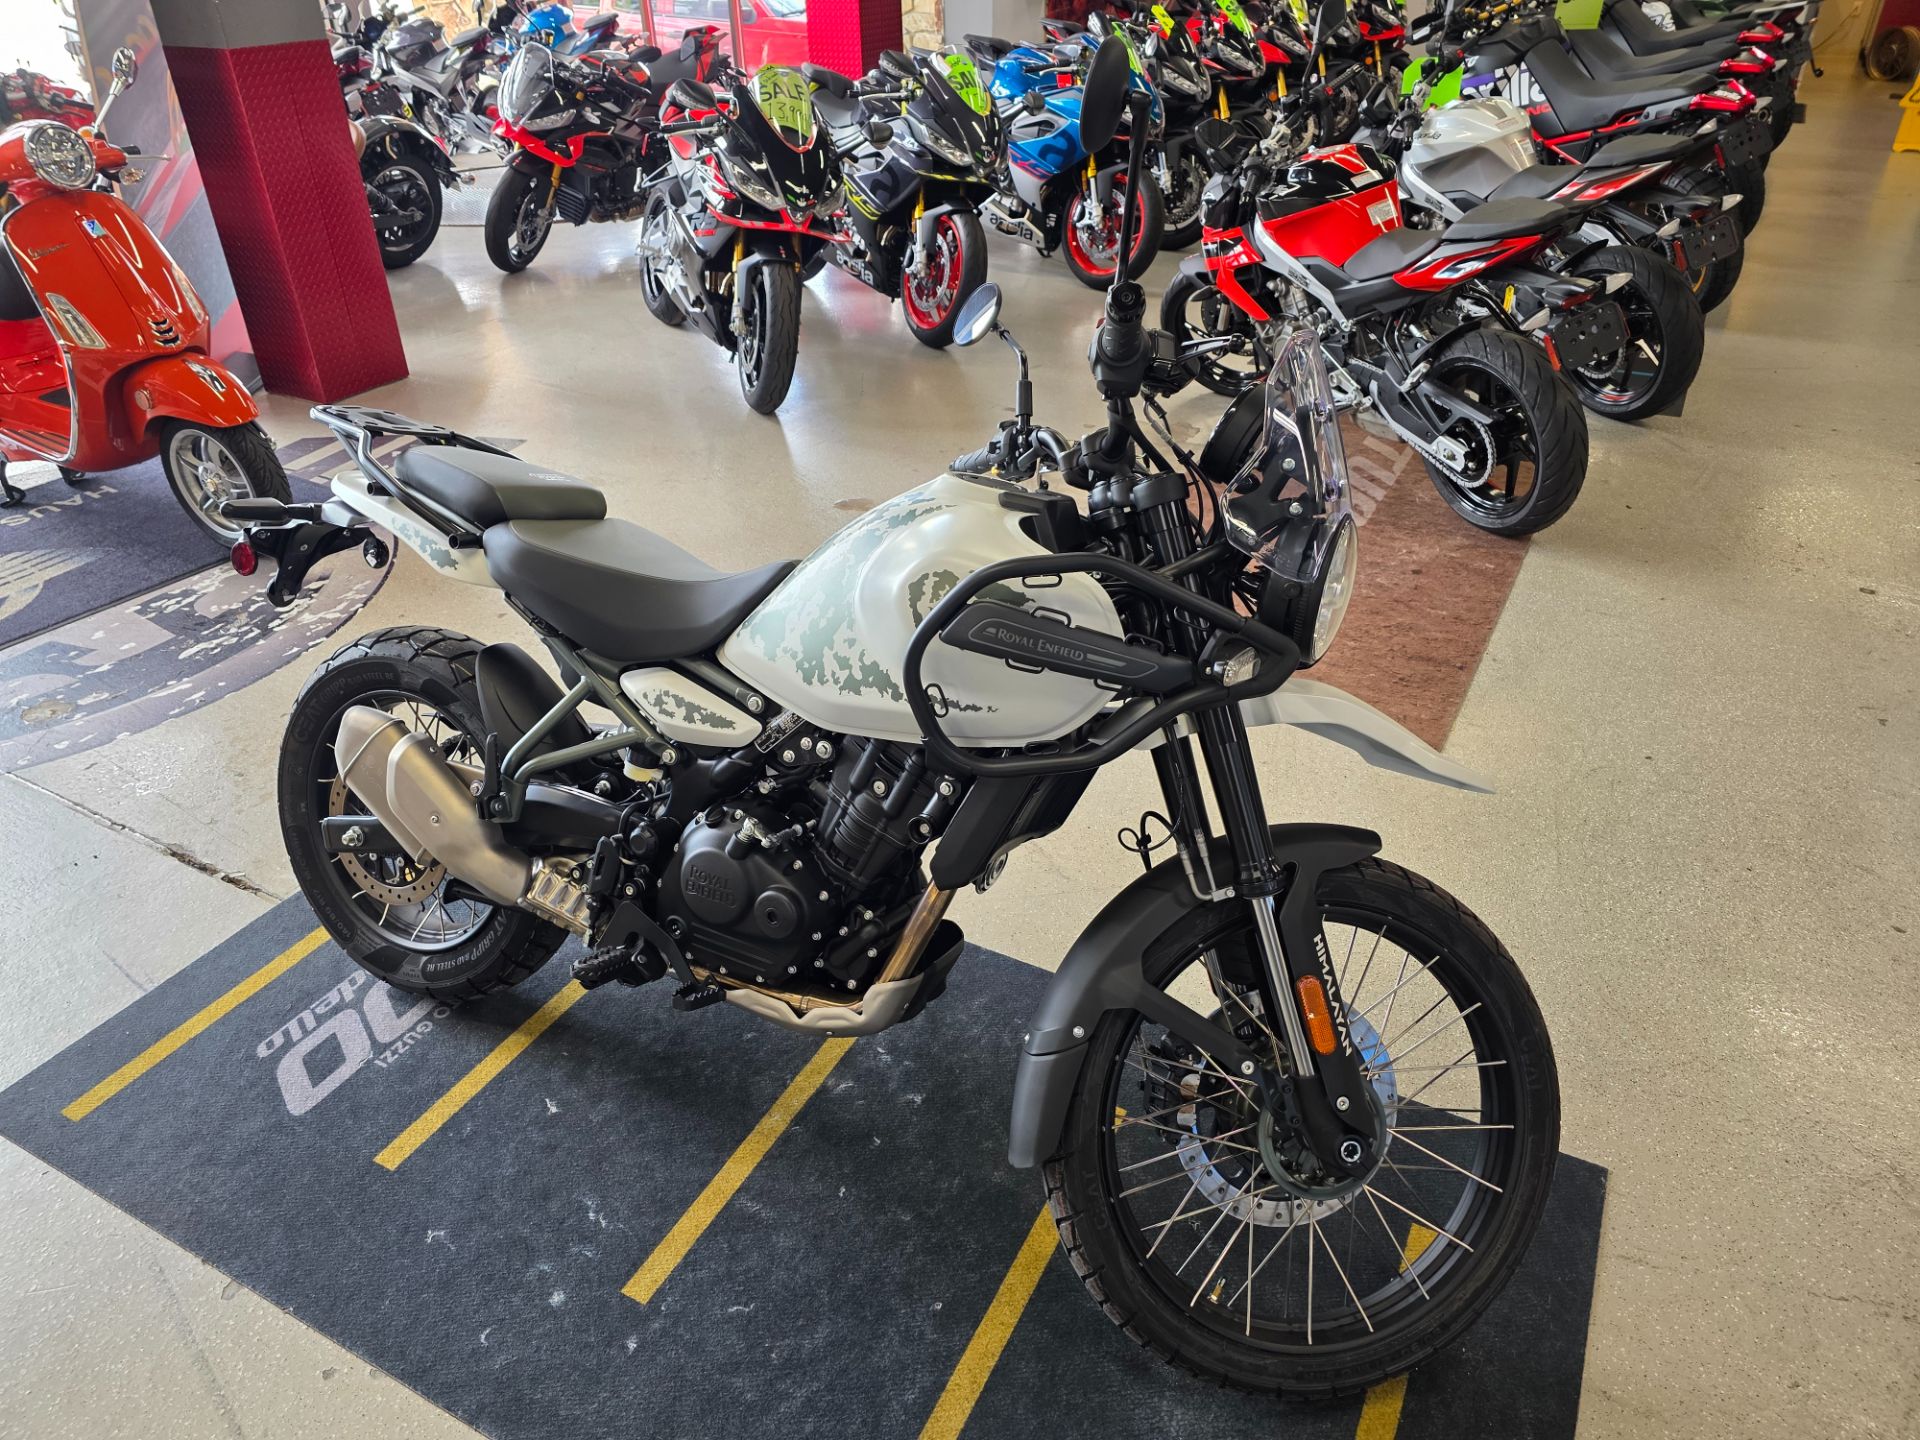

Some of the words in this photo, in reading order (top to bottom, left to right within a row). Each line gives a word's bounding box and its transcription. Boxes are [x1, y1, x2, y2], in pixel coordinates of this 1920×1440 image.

[760, 82, 805, 102] SALE
[0, 485, 119, 526] HAUS
[998, 628, 1035, 648] ROYAL
[1037, 639, 1084, 661] ENFIELD
[689, 865, 729, 890] ROYAL
[686, 880, 737, 909] ENFIELD
[471, 930, 495, 961] GRIPP
[426, 963, 436, 972] RE
[436, 960, 456, 971] STEEL
[1313, 933, 1353, 1057] HIMALAYAN
[374, 1020, 433, 1068] GUZZI
